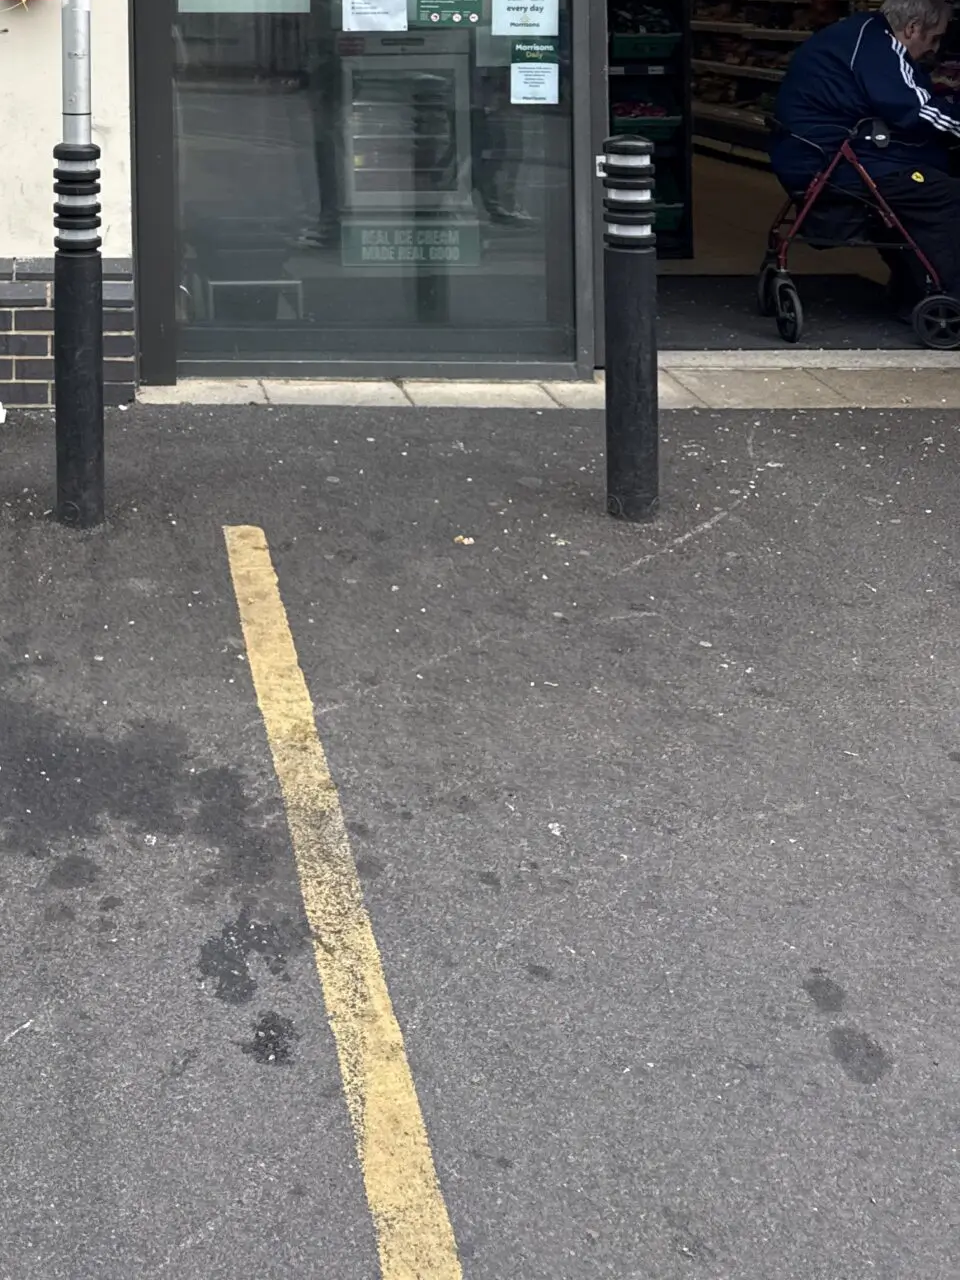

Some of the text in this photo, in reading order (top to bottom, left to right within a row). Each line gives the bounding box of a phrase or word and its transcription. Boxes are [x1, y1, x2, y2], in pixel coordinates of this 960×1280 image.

[529, 4, 545, 14] day
[515, 43, 554, 51] Morrisons
[361, 229, 460, 245] REAL ICE CREAM
